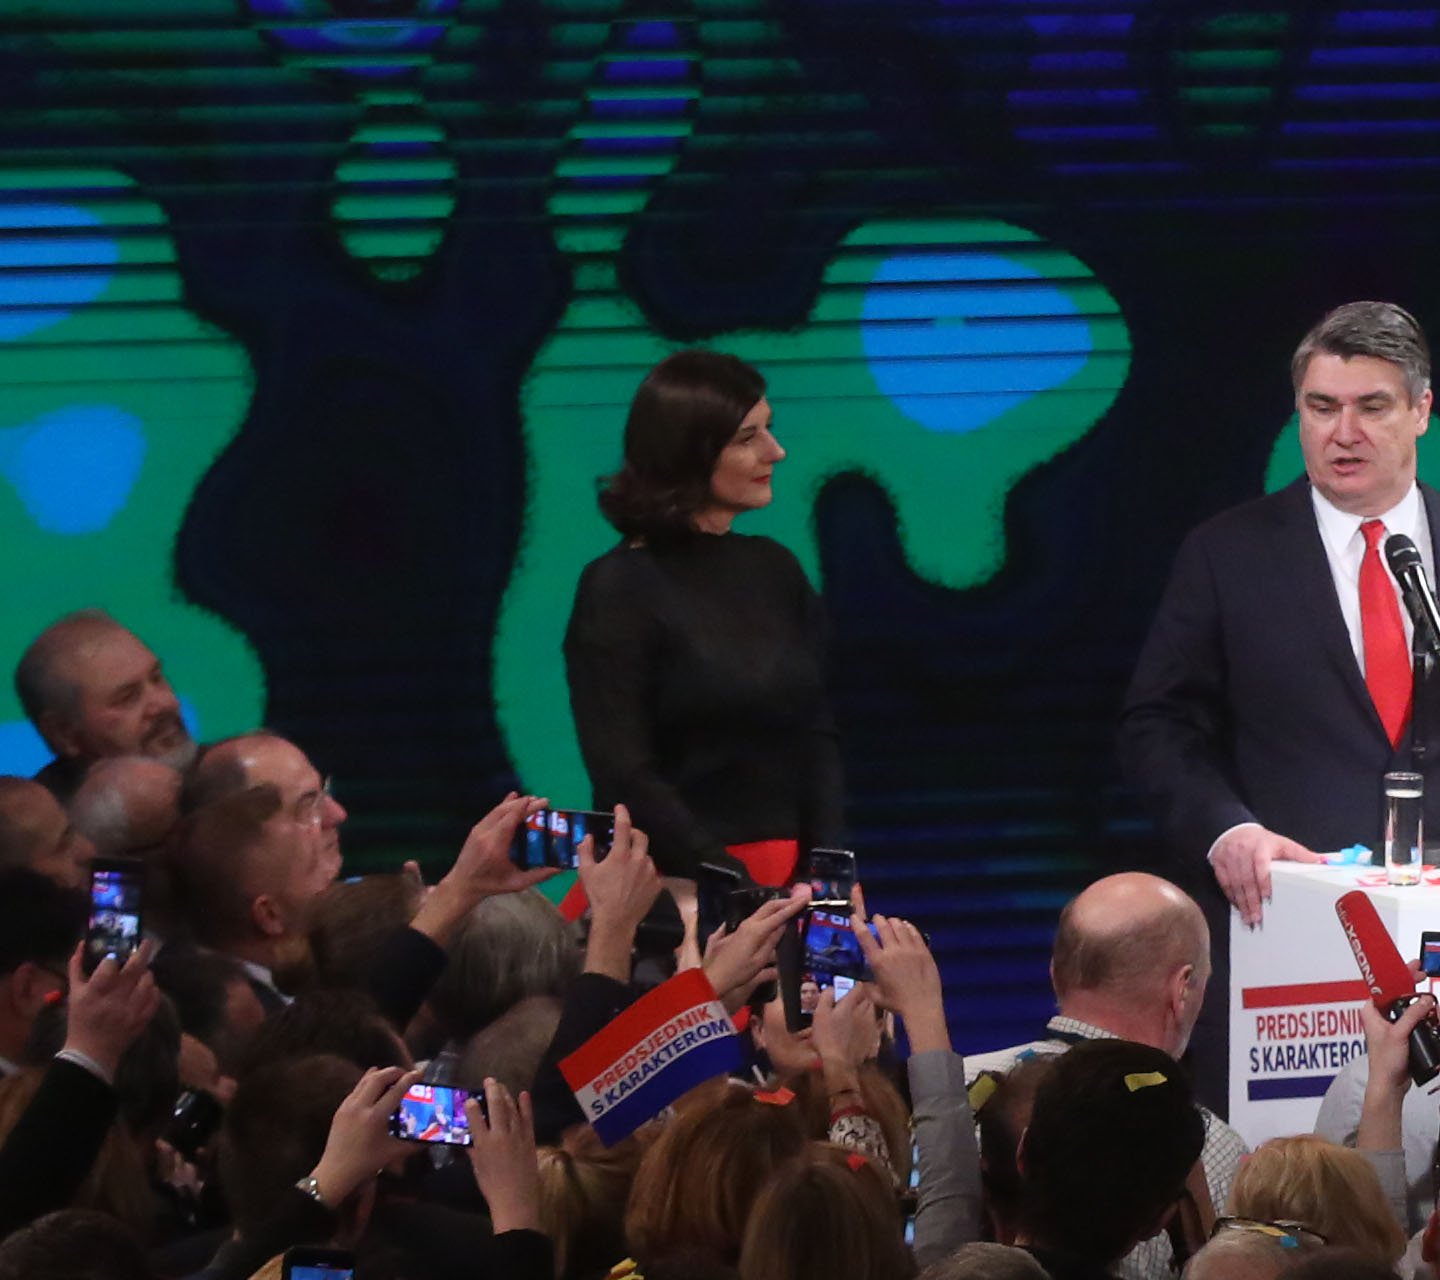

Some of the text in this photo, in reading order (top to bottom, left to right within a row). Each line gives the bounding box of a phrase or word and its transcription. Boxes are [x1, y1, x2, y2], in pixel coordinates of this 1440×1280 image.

[591, 1006, 713, 1095] PREDSJEDNIK
[591, 1018, 731, 1115] S KARAKTEROM
[1249, 1039, 1368, 1073] S KARAKTERO
